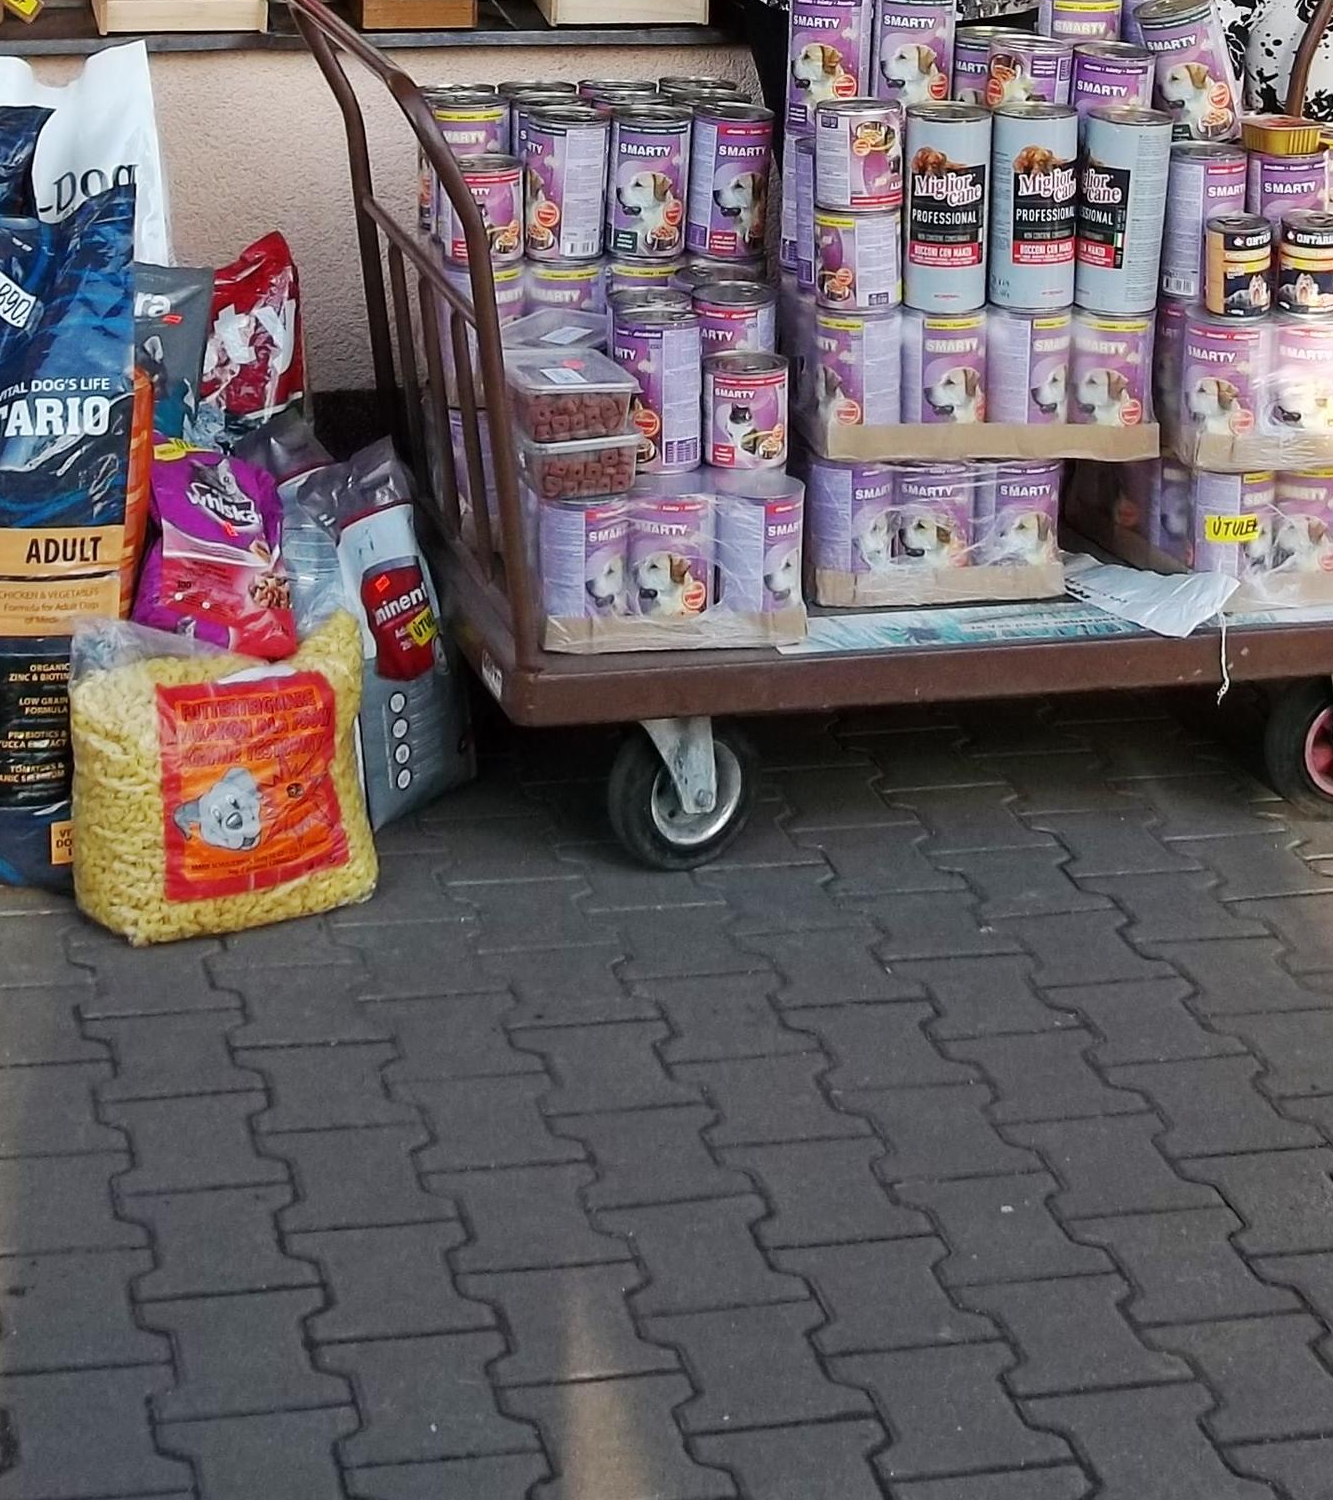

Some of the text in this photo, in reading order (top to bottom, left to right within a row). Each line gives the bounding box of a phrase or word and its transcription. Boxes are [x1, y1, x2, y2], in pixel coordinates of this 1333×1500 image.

[793, 15, 840, 30] SMARTY
[884, 15, 935, 30] SMARTY
[1055, 20, 1107, 36] SMARTY
[1147, 34, 1197, 51] SMARTY
[1077, 78, 1128, 97] SMARTY
[620, 143, 670, 157] SMARTY
[718, 145, 767, 158] SMARTY
[947, 183, 982, 206] cane
[1087, 187, 1122, 204] cane
[1207, 185, 1245, 198] SMART
[1264, 181, 1316, 195] SMARTY
[912, 208, 977, 224] PROFESSIONAL
[926, 338, 979, 352] SMARTY
[30, 378, 77, 393] DOG'S
[80, 377, 110, 391] LIFE
[714, 386, 755, 400] SMARTY
[901, 483, 954, 498] SMARTY
[1000, 483, 1052, 498] SMARTY
[25, 535, 103, 565] ADULT
